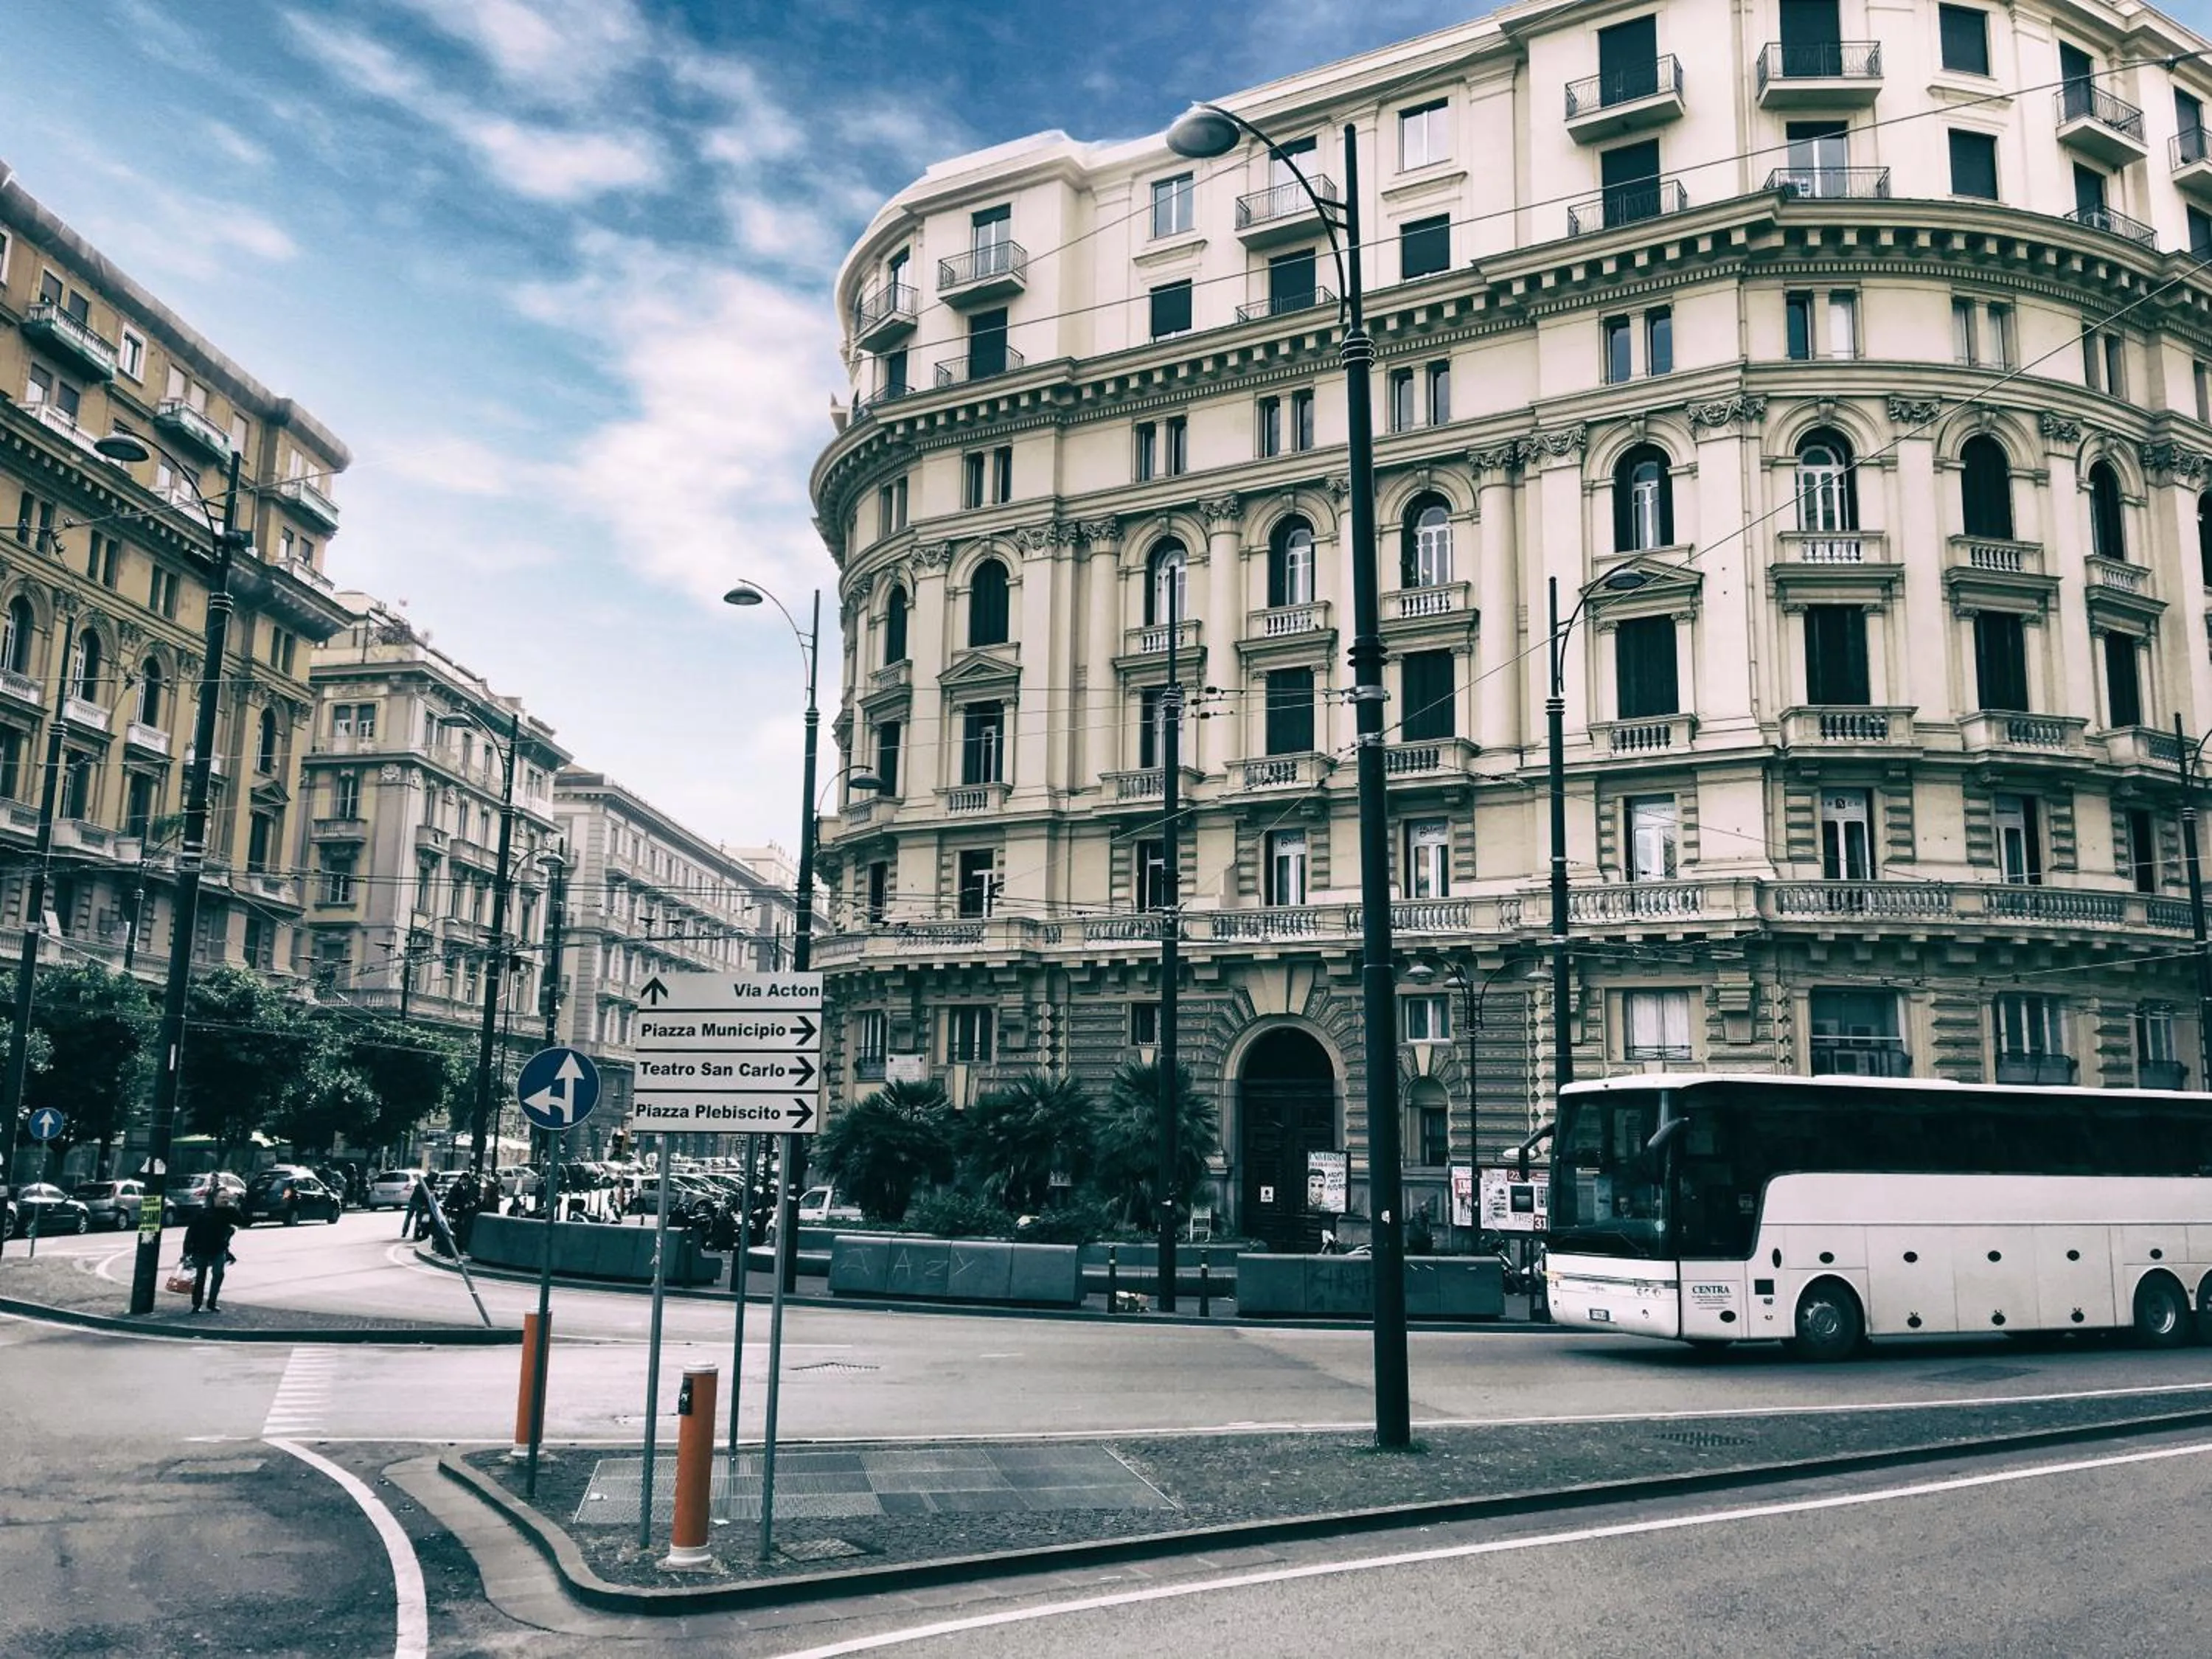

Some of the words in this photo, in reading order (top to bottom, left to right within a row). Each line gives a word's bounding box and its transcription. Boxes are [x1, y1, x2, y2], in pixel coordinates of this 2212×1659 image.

[734, 983, 762, 997] Via
[768, 984, 819, 997] Acton
[641, 1023, 696, 1037] Piazza
[701, 1023, 786, 1040] Municipio
[640, 1061, 695, 1077] Teatro
[700, 1062, 733, 1077] San
[739, 1062, 785, 1077] Carlo
[636, 1104, 689, 1119] Piazza
[695, 1105, 781, 1120] Plebiscito
[1692, 1285, 1730, 1293] CENTRA
